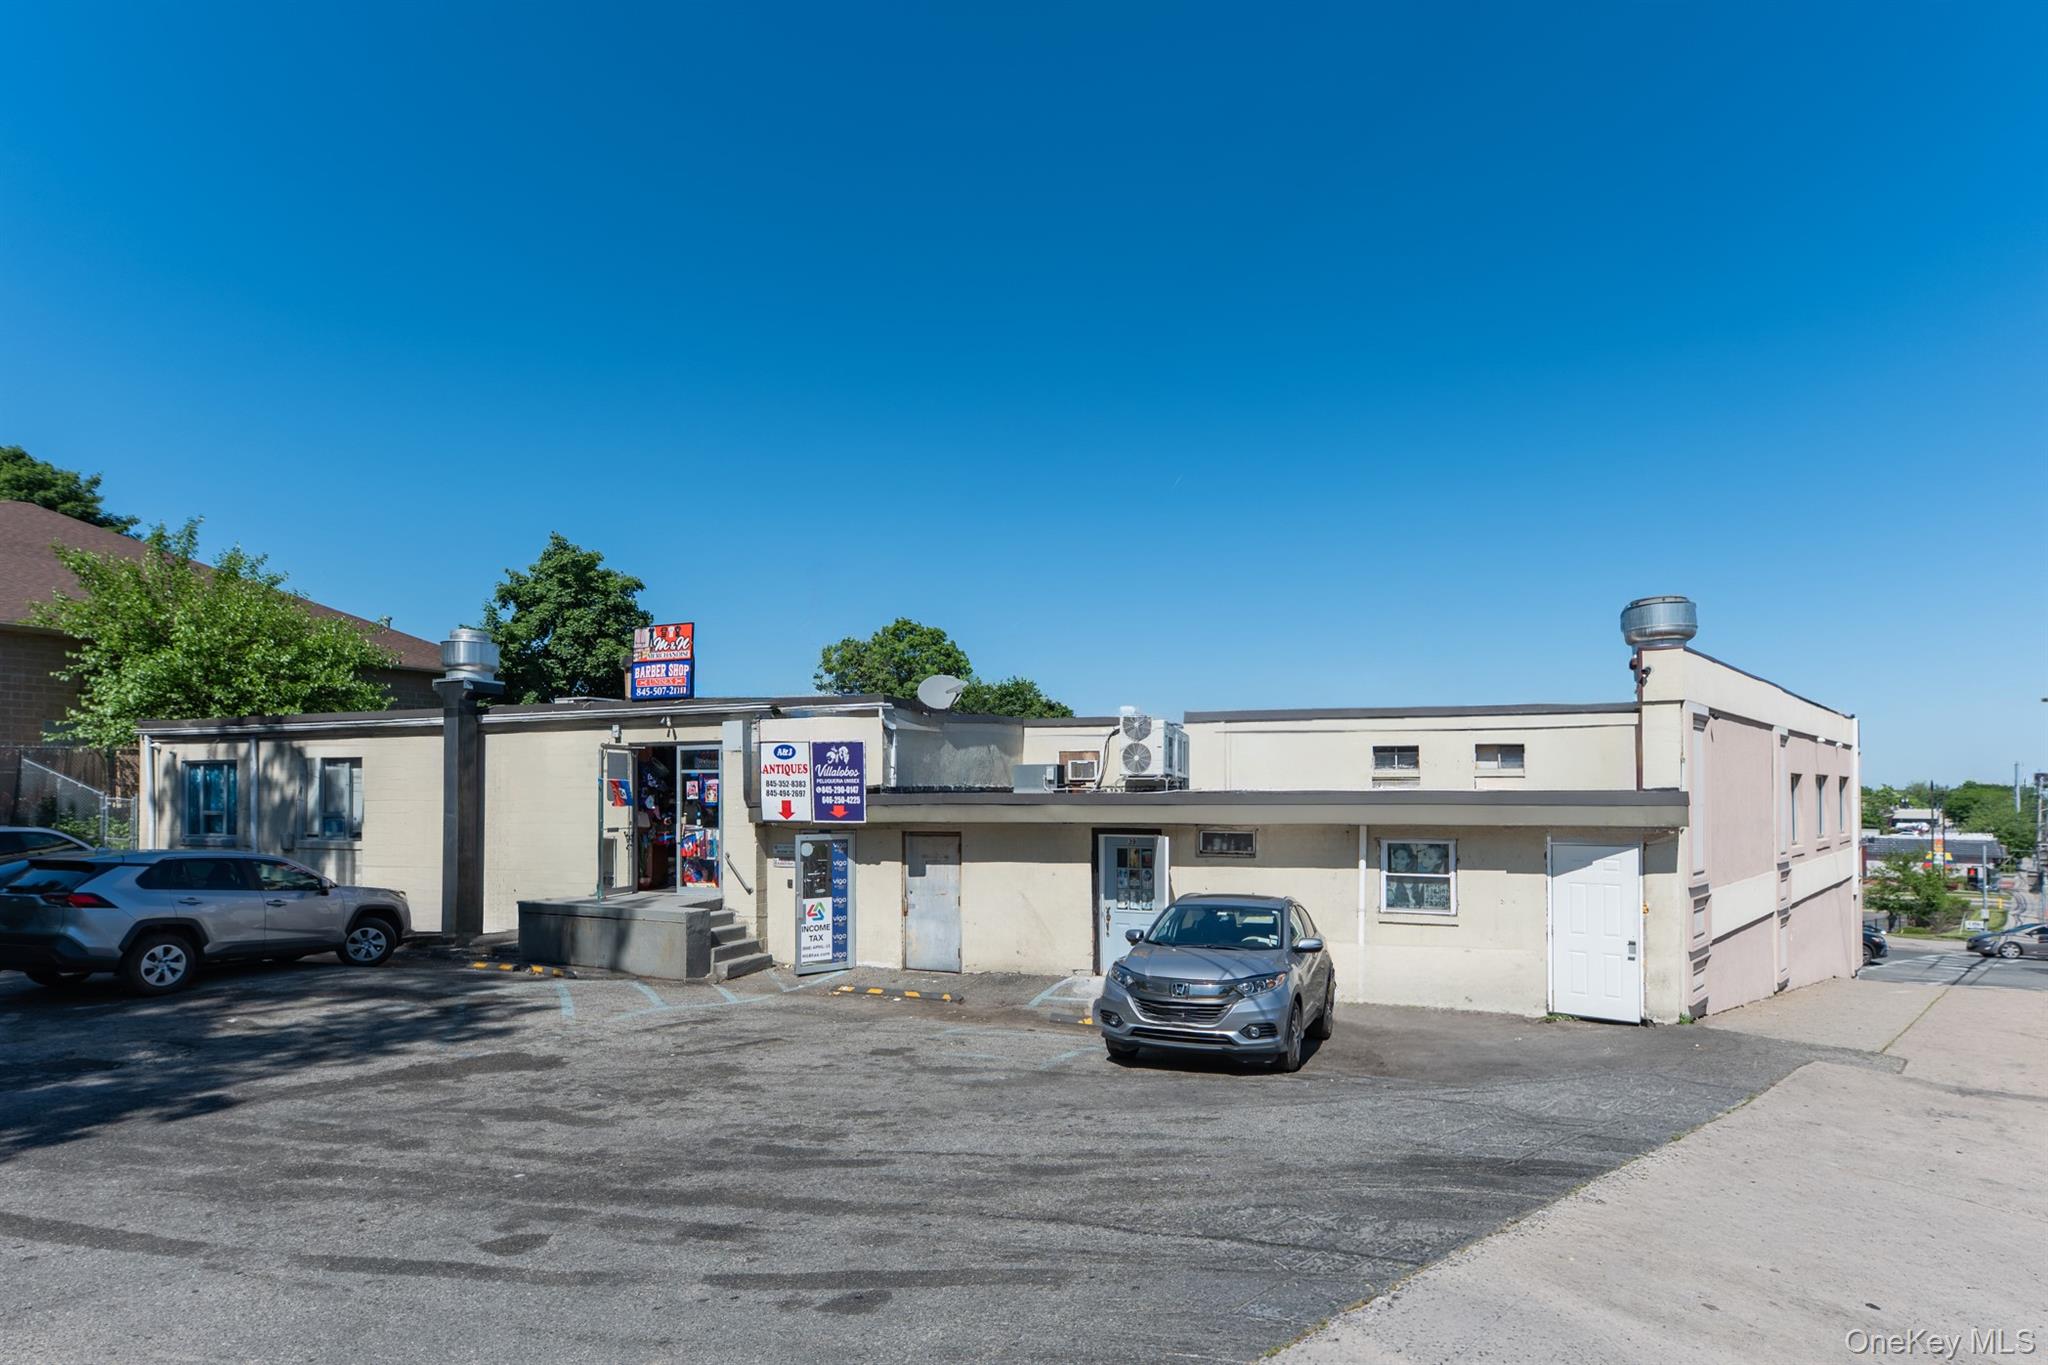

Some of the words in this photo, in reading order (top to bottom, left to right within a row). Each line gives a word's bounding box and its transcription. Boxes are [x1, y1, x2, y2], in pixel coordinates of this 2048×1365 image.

[634, 664, 666, 678] BARBER
[668, 664, 690, 676] SHOP
[762, 763, 808, 776] ANTIQUES
[815, 764, 860, 777] Villalobos
[801, 924, 831, 932] INCOME
[809, 934, 824, 942] TAX
